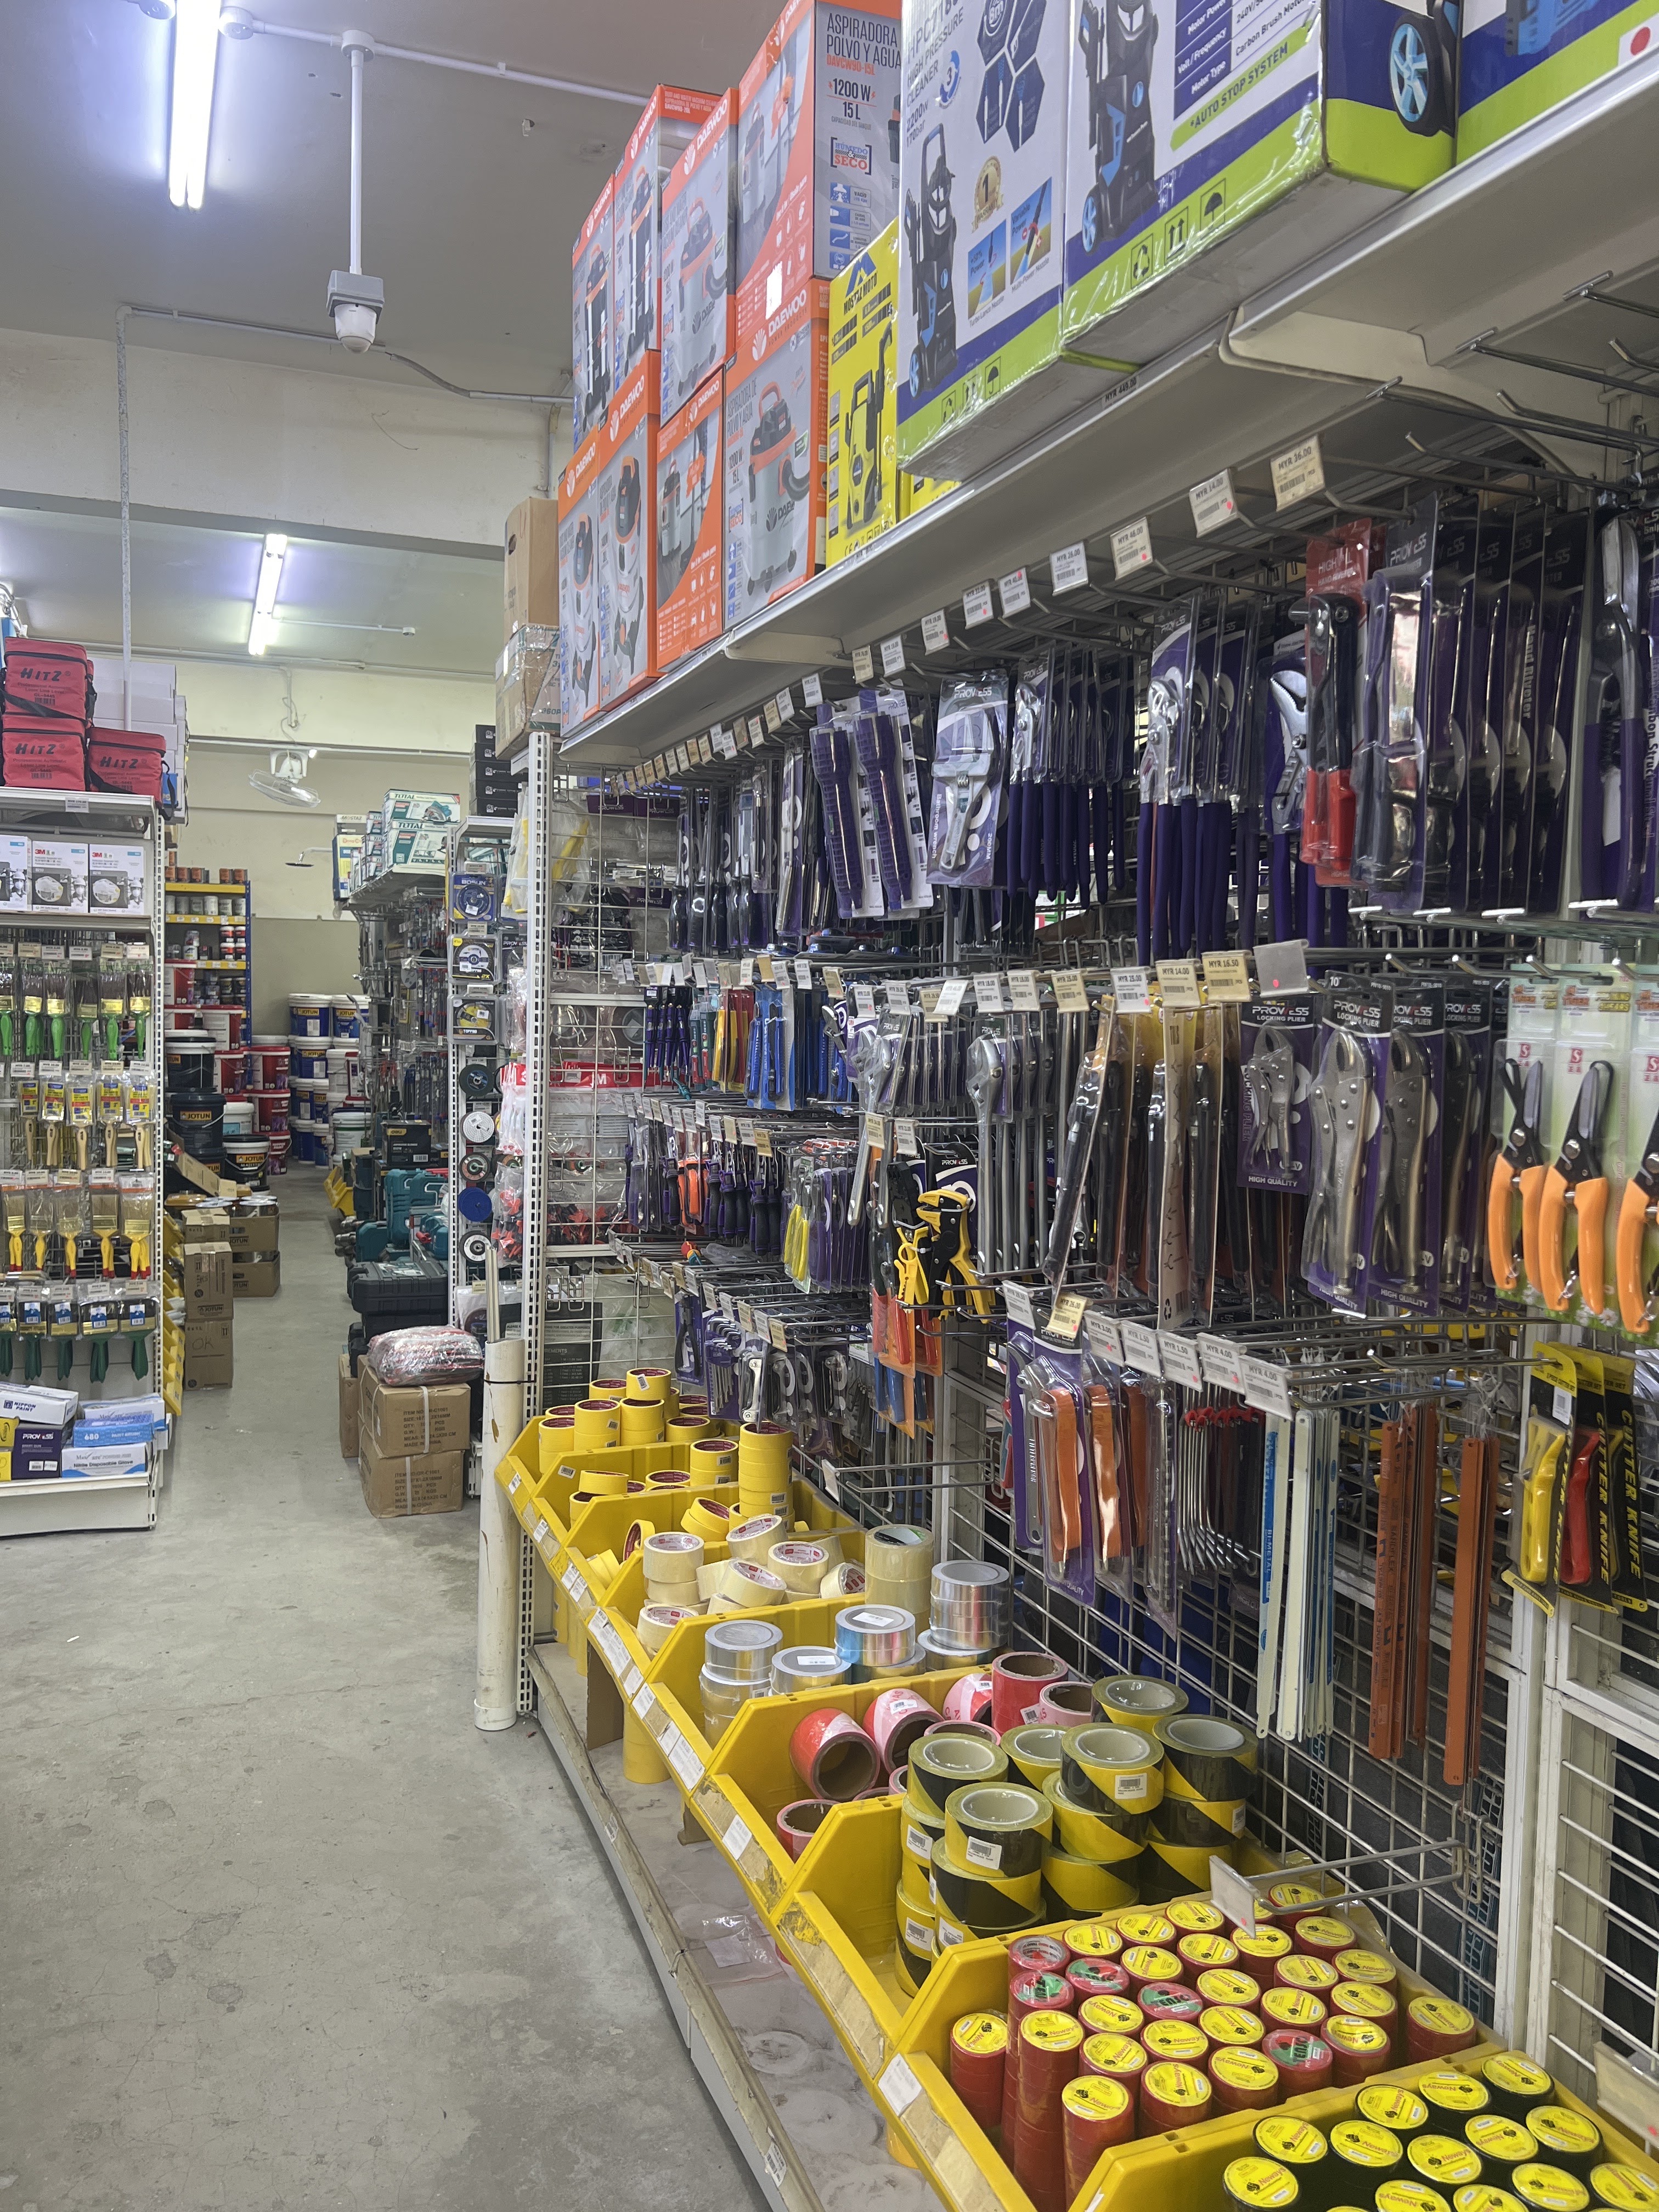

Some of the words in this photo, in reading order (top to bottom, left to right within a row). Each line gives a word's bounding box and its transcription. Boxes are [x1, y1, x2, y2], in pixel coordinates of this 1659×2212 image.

[827, 13, 898, 47] ASPIRADORA
[1188, 14, 1206, 35] Motor
[1235, 32, 1260, 56] Carbon
[1261, 13, 1282, 35] Brush
[827, 34, 860, 60] POLVO
[864, 43, 870, 63] Y
[873, 46, 901, 70] AGUA
[907, 59, 923, 88] HIGH
[925, 7, 964, 65] PRESSURE
[907, 60, 939, 108] CLEANER
[1192, 74, 1209, 94] Motor
[1210, 60, 1226, 79] Type
[1221, 78, 1245, 106] STOP
[1248, 42, 1288, 84] SYSTEM
[833, 78, 858, 99] 1200
[861, 84, 871, 102] W
[843, 101, 853, 118] 15
[856, 104, 860, 120] L
[697, 98, 727, 150] DAEWOO
[835, 142, 868, 155] HÚMEDO
[834, 154, 867, 170] SECO
[768, 289, 806, 337] DAEWOO
[619, 375, 645, 420] DAEWOO
[698, 380, 719, 407] DAEWOO
[575, 442, 596, 479] DAEWOO
[1278, 457, 1293, 470] MYR
[1294, 447, 1312, 462] 36.00
[1196, 488, 1207, 500] MYR
[1118, 534, 1129, 545] MYR
[1057, 555, 1066, 563] MYR
[1525, 625, 1536, 663] Hand
[1522, 666, 1534, 719] Riveter
[1337, 1013, 1362, 1024] LOCKING
[1363, 1017, 1380, 1028] PLIER
[1248, 1176, 1266, 1184] HIGH
[1267, 1178, 1297, 1187] QUALITY
[1059, 1299, 1068, 1307] MYR
[1381, 1289, 1396, 1300] HIGH
[1397, 1293, 1428, 1308] QUALITY
[1091, 1321, 1101, 1330] MYR
[1102, 1325, 1112, 1334] 3.00
[1127, 1330, 1138, 1340] MYR
[1164, 1341, 1176, 1351] MYR
[1177, 1345, 1188, 1355] 1.50
[1206, 1344, 1218, 1354] MYR
[1220, 1348, 1232, 1359] 4.00
[1249, 1365, 1262, 1376] MYR
[1263, 1370, 1277, 1381] 4.00
[1596, 1412, 1609, 1505] CUTTER
[1622, 1409, 1637, 1501] CUTTER
[1599, 1510, 1609, 1585] KNIFE
[1627, 1506, 1640, 1579] KNIFE
[1087, 2000, 1118, 2018] Neways
[1113, 2040, 1133, 2060] Neways
[1215, 2057, 1249, 2069] Neways
[1392, 2089, 1403, 2111] Neways
[1290, 2121, 1308, 2142] Neways
[1442, 2149, 1471, 2162] Neways
[1259, 2168, 1286, 2186] Neways
[1379, 2192, 1417, 2207] Neways
